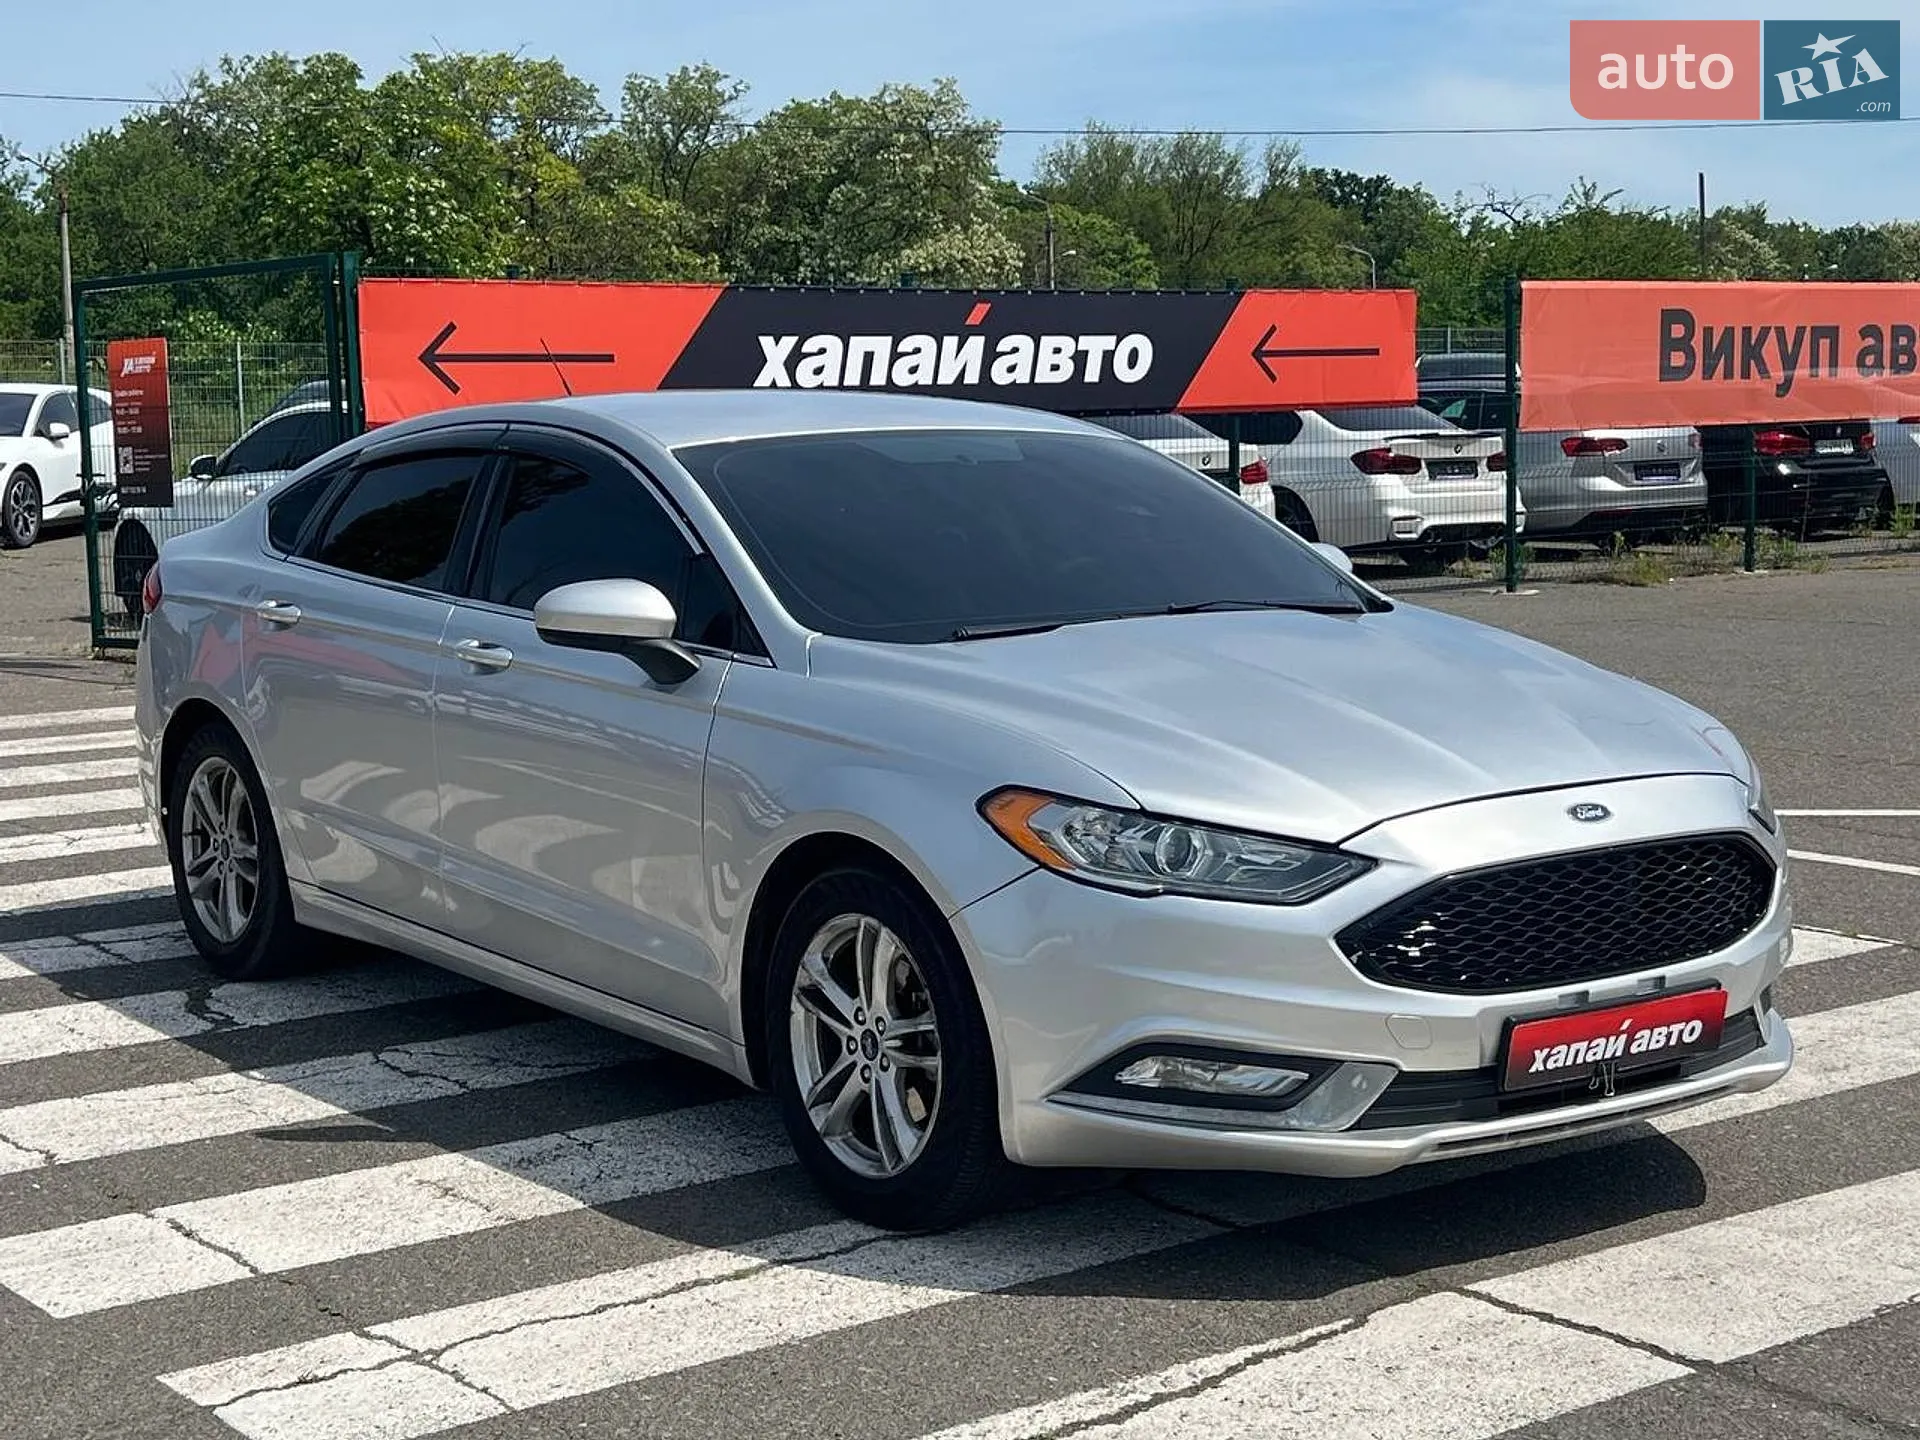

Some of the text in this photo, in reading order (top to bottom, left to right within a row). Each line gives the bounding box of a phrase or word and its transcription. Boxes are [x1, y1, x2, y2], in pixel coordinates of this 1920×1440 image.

[753, 302, 1153, 388] хапай авто
[1659, 308, 1920, 397] Викуп ав
[1528, 1018, 1703, 1074] хапай авто
